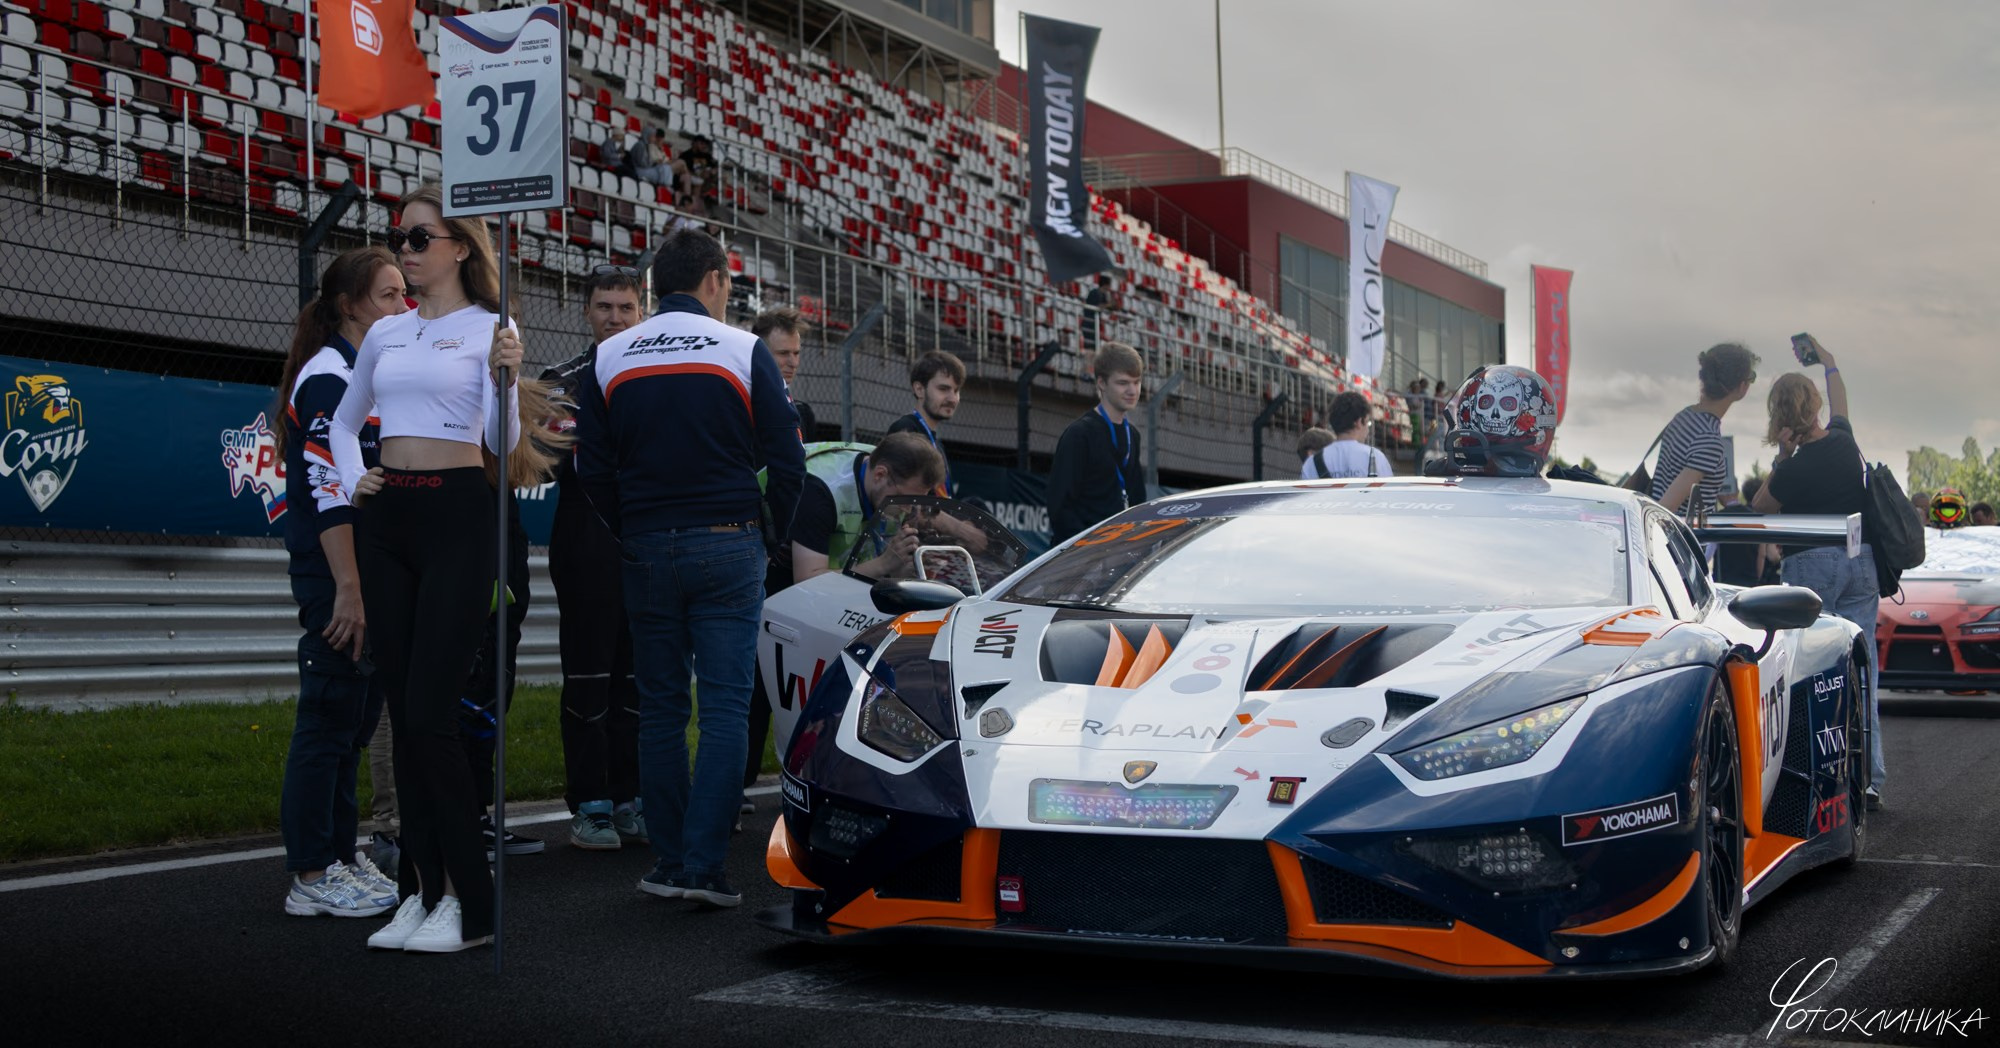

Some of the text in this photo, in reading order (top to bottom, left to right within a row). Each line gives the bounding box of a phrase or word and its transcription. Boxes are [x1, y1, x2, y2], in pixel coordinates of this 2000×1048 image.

[466, 80, 536, 156] 37
[1043, 61, 1074, 167] TODAY
[1362, 207, 1383, 342] VOICE
[622, 345, 691, 357] motorsport
[628, 333, 700, 349] iskra
[0, 428, 89, 477] Сочи
[222, 431, 256, 448] СМП
[997, 501, 1048, 533] RACING
[1359, 501, 1455, 512] RACING
[1074, 517, 1188, 547] 37
[1816, 729, 1846, 756] VIVA
[1600, 803, 1672, 832] YOKOHAMA
